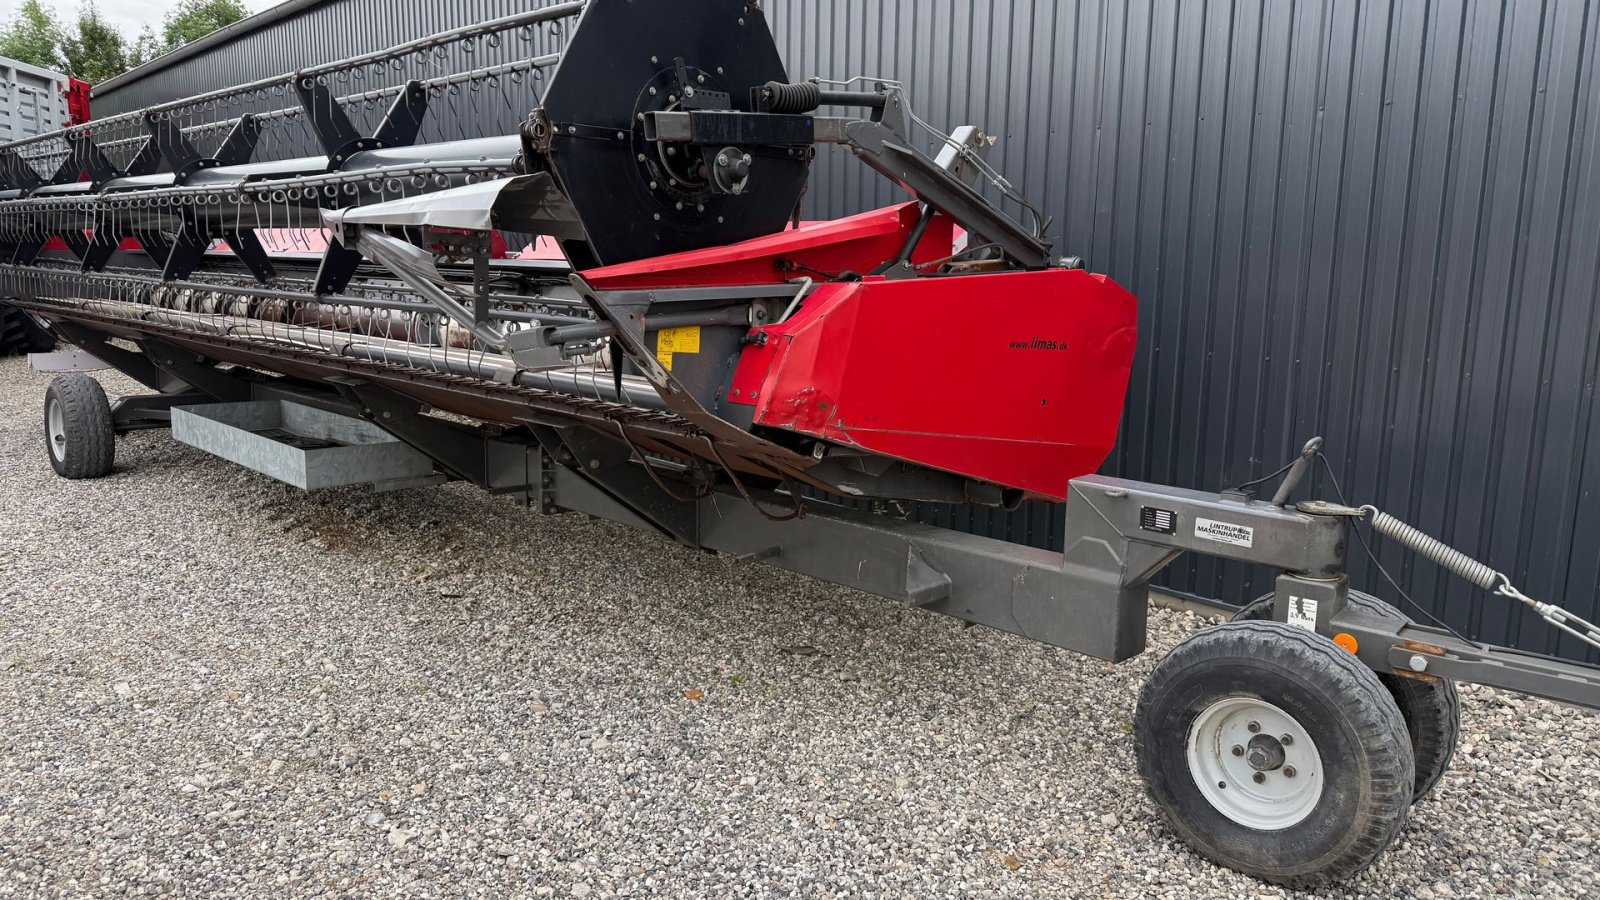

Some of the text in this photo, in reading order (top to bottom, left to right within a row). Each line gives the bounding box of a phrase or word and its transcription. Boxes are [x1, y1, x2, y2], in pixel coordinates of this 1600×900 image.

[1009, 336, 1067, 350] www.limas.dk
[1196, 525, 1250, 541] MASKINHANDEL
[1209, 522, 1238, 532] LINTRUP
